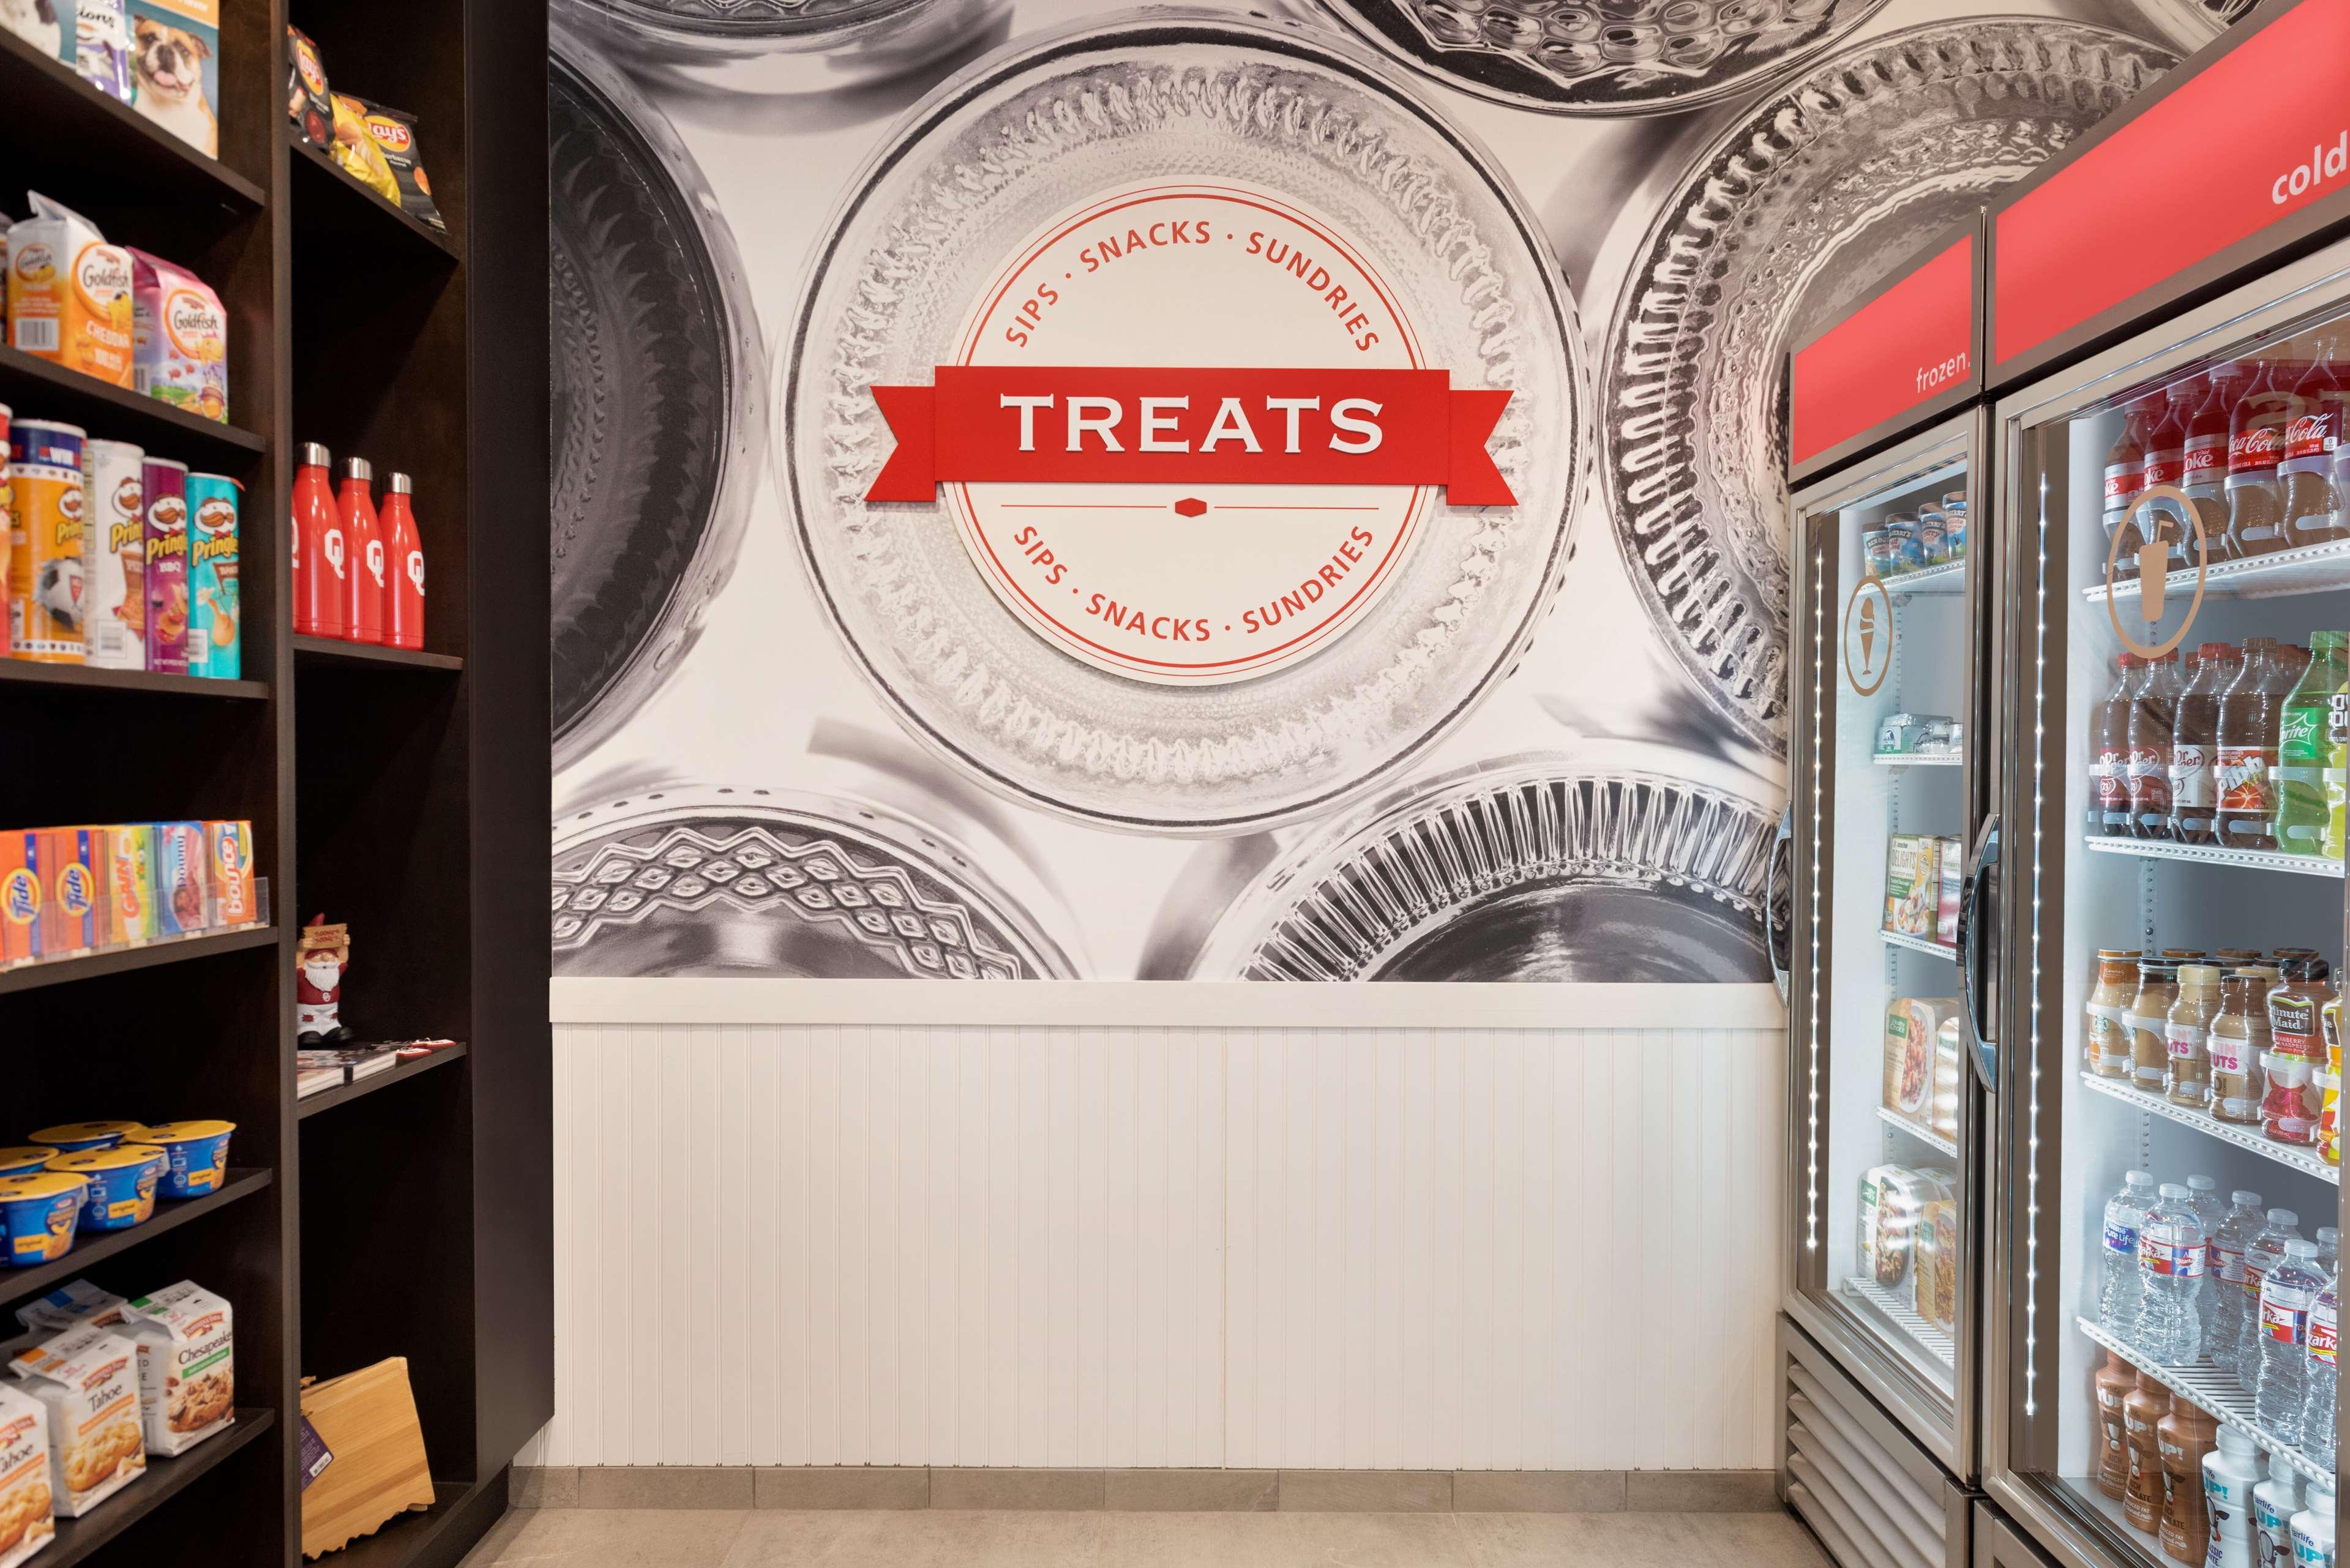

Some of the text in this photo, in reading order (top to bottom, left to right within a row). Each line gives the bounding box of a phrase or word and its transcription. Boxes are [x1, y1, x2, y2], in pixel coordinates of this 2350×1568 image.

[2272, 130, 2348, 205] cold
[83, 264, 129, 288] Goldfish
[1006, 220, 1379, 351] SIPS SNACKS SUNDRIES
[173, 310, 219, 330] Goldfish
[1000, 394, 1383, 454] TREATS
[159, 561, 182, 573] BBQ
[192, 535, 239, 568] Pringle
[1014, 526, 1372, 642] SIPS SNACKS SUNDRIES
[2280, 725, 2309, 742] rite
[65, 869, 88, 910] Tide
[222, 837, 244, 914] bounce
[12, 875, 35, 918] Tide
[2212, 1054, 2238, 1070] UTS
[178, 1331, 232, 1365] Chesapeake
[89, 1384, 122, 1411] Tahoe
[1, 1444, 32, 1472] ahoe
